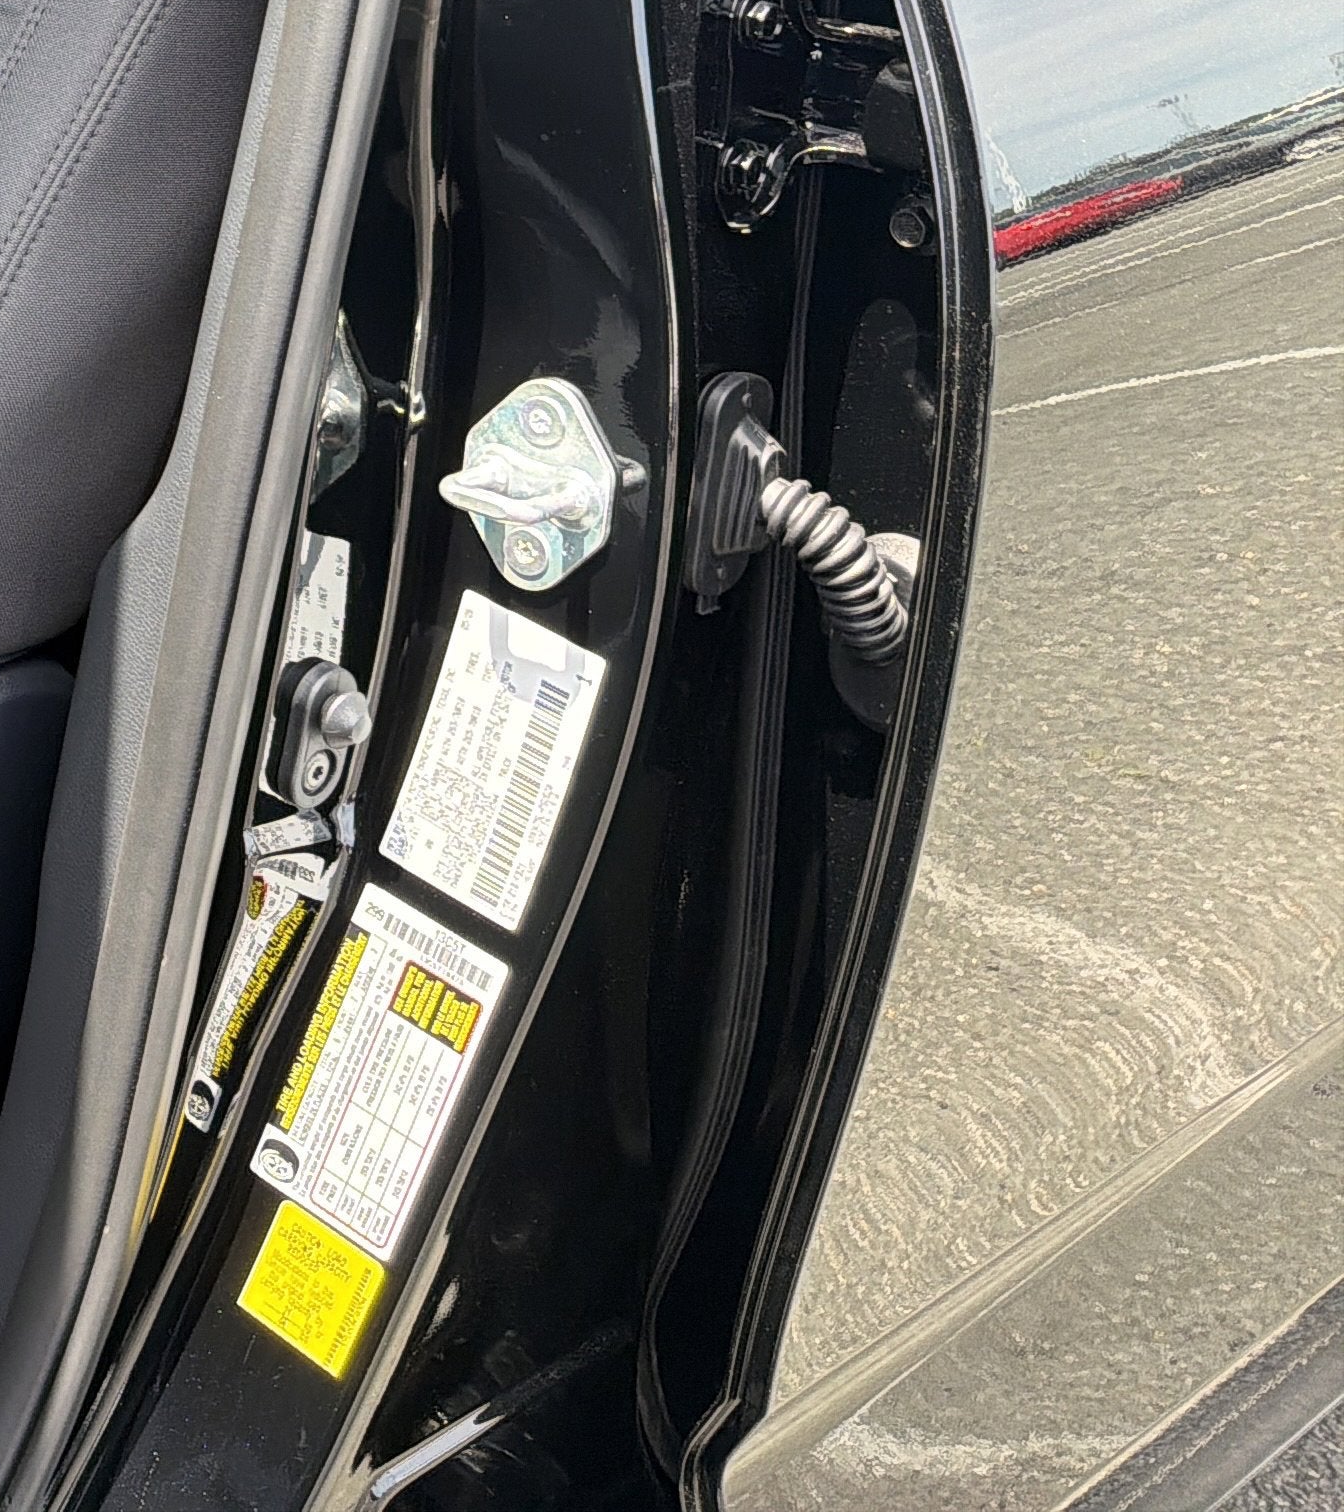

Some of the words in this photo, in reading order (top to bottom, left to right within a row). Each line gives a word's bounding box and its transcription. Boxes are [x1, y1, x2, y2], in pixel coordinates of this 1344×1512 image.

[315, 936, 355, 1015] INFORMATION
[294, 1011, 324, 1065] LOADING
[285, 1058, 305, 1088] AND
[274, 1084, 294, 1114] TIRE
